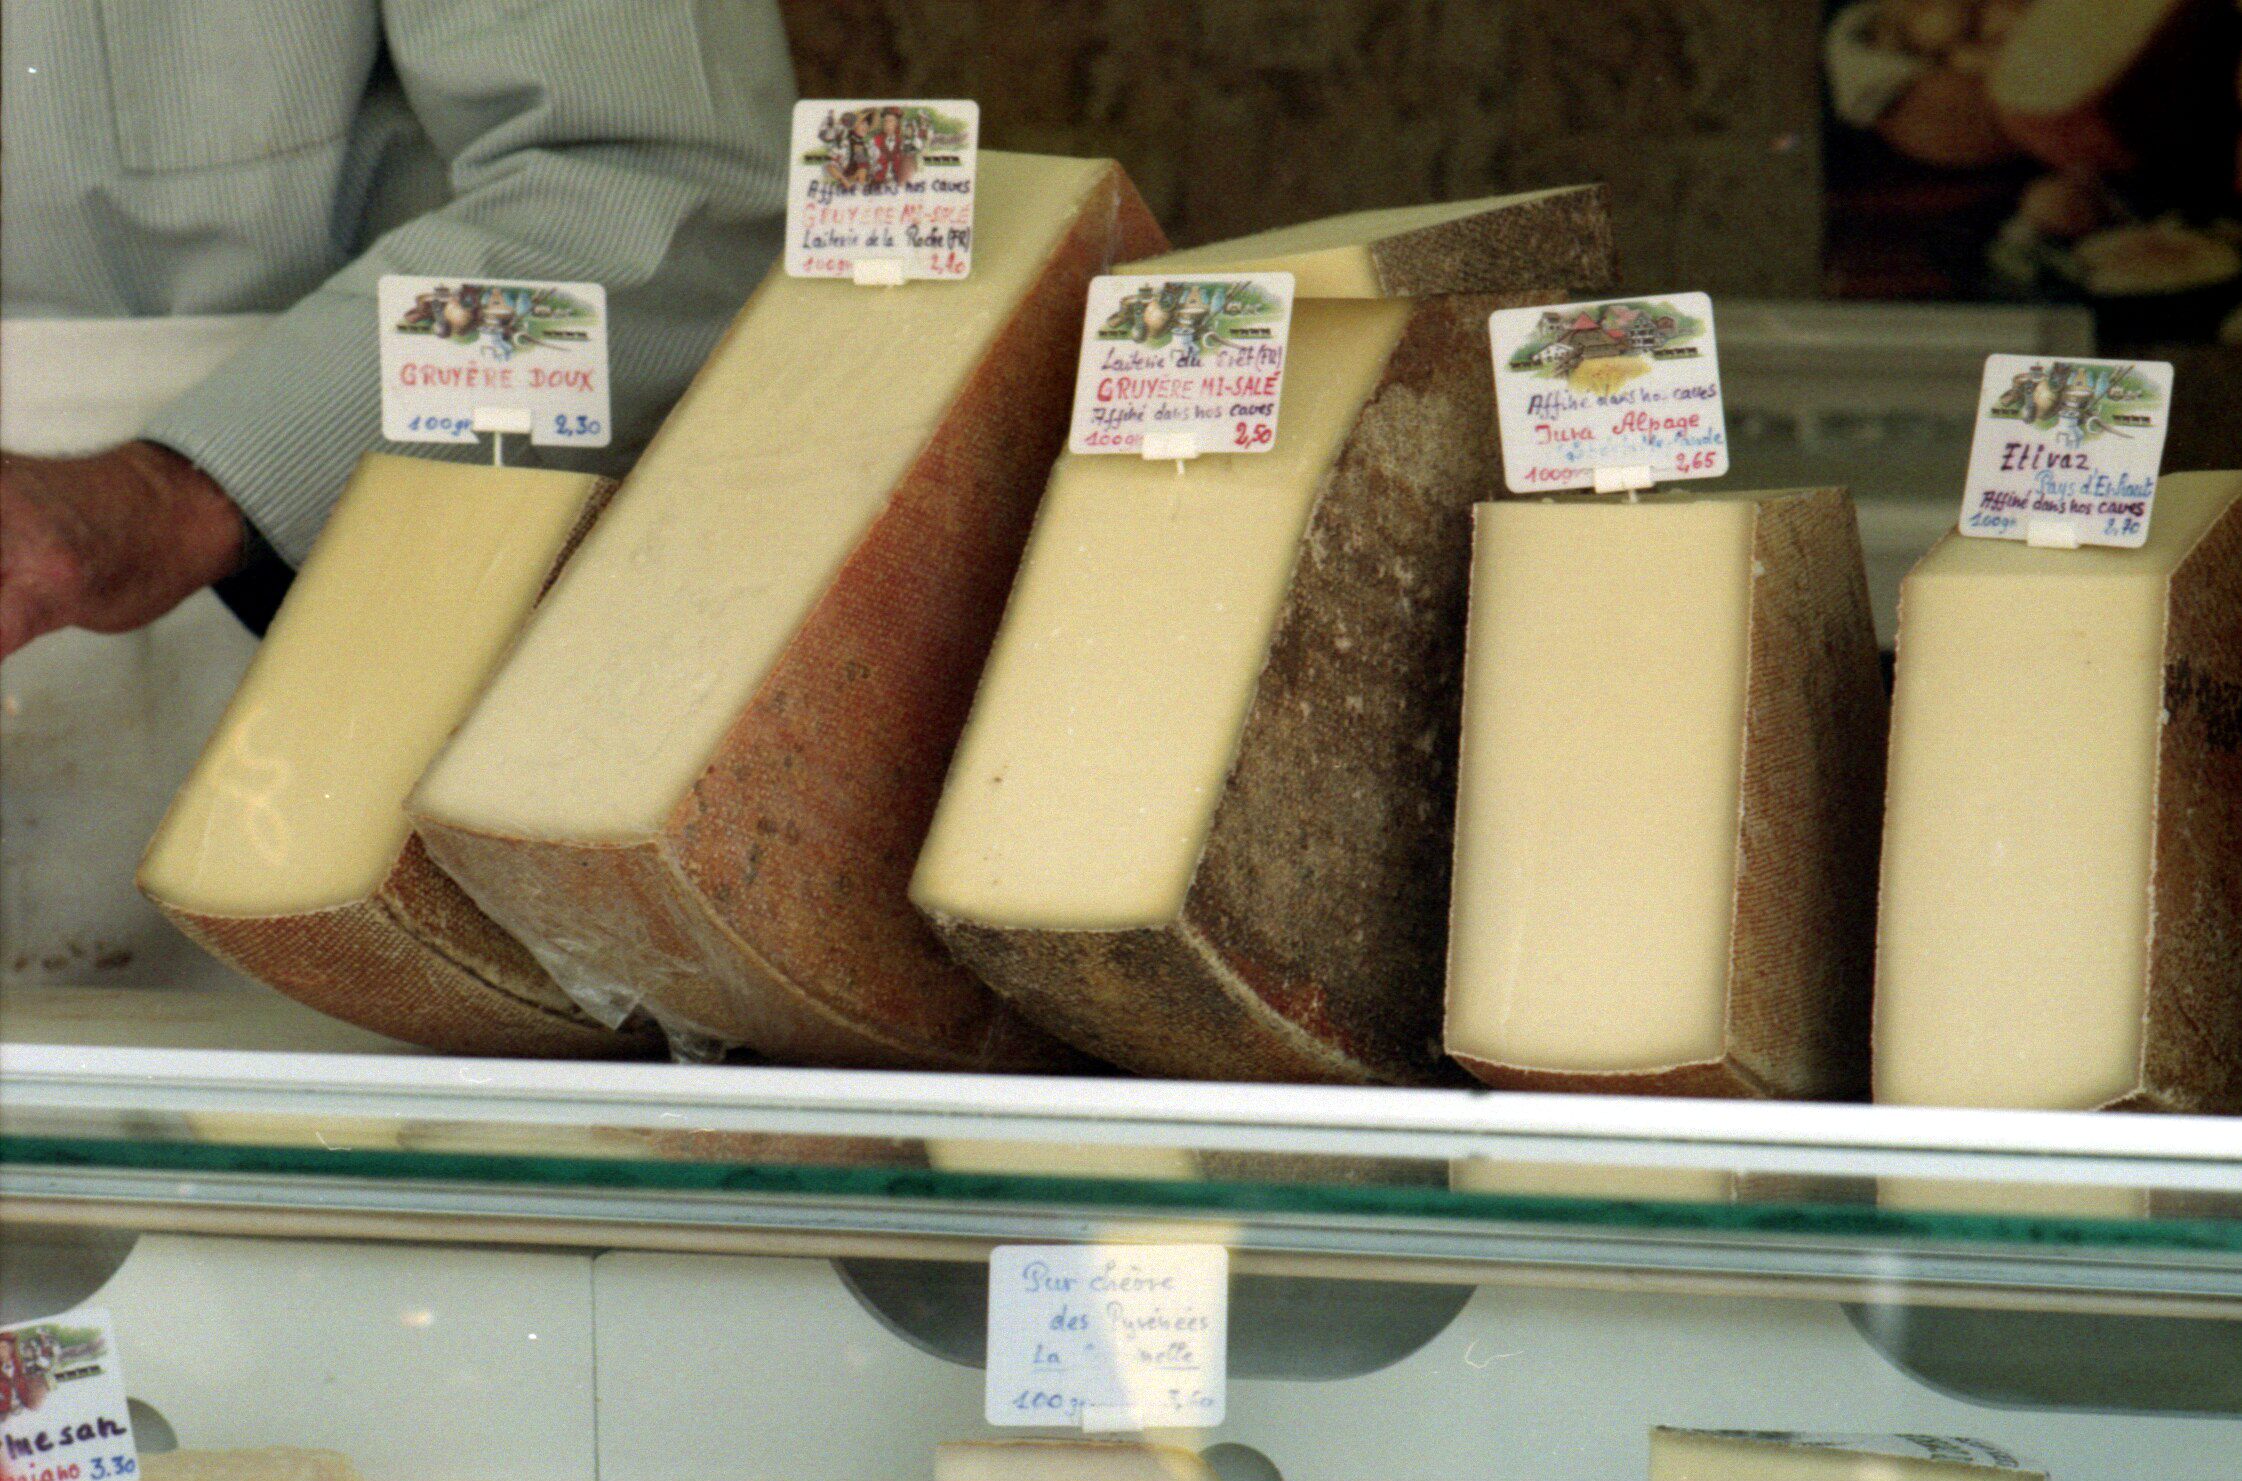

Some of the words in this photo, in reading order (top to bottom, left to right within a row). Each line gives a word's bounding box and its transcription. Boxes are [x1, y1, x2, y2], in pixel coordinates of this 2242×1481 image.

[931, 179, 970, 193] caves
[400, 360, 514, 388] GRUYÈRE
[530, 366, 594, 392] DOUX
[1097, 374, 1194, 402] GRUYÈRE
[1199, 370, 1281, 398] MI-SALÉ
[1673, 383, 1717, 400] caves
[1155, 403, 1189, 421] dans
[1194, 404, 1223, 420] nos
[1229, 402, 1274, 417] caves
[555, 414, 601, 437] 2,30
[1234, 421, 1273, 450] 2,50
[1535, 424, 1596, 445] Jura
[1612, 410, 1701, 435] Alpage
[1675, 451, 1717, 474] 2,65
[2033, 492, 2066, 514] dans
[2070, 499, 2091, 514] nos
[2098, 500, 2144, 517] caves
[1022, 1261, 1077, 1293] Pur
[1051, 1305, 1089, 1330] des
[1032, 1345, 1061, 1364] La
